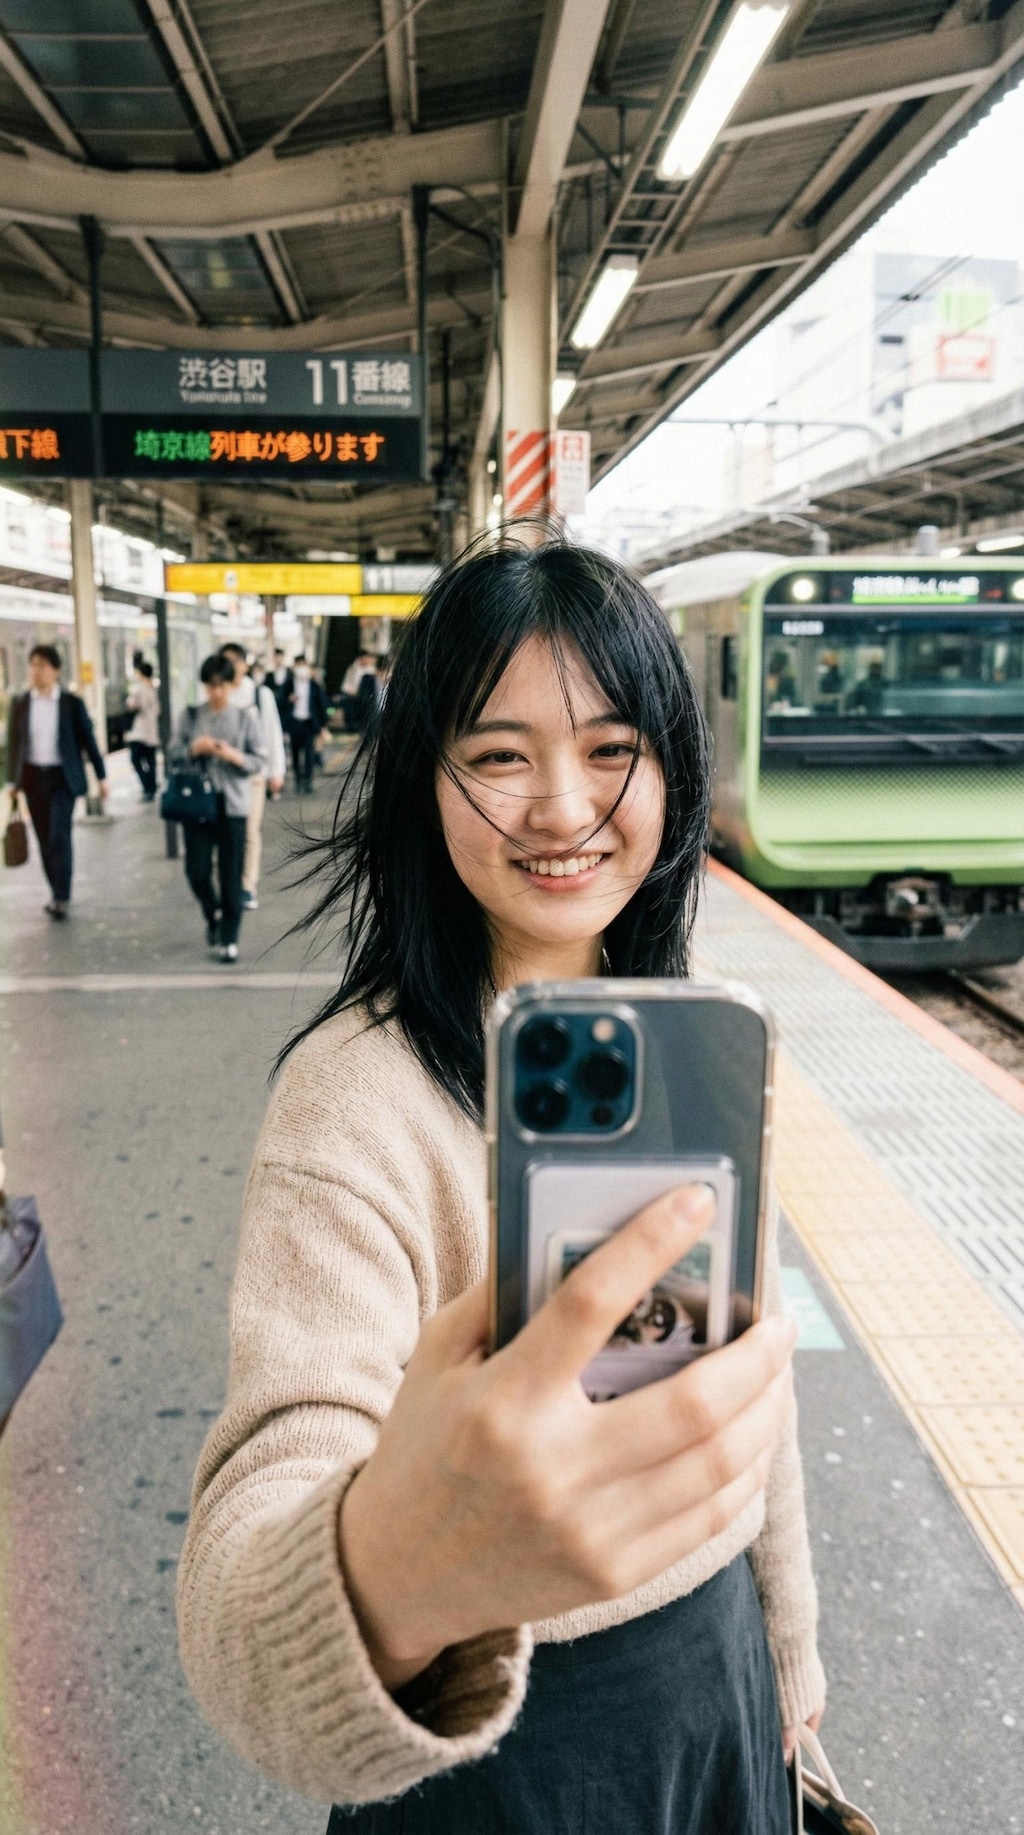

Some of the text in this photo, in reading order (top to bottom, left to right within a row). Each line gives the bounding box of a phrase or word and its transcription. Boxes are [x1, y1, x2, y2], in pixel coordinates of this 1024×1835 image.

[179, 357, 267, 389] 渋谷駅
[134, 430, 386, 463] 埼京線列車が参ります
